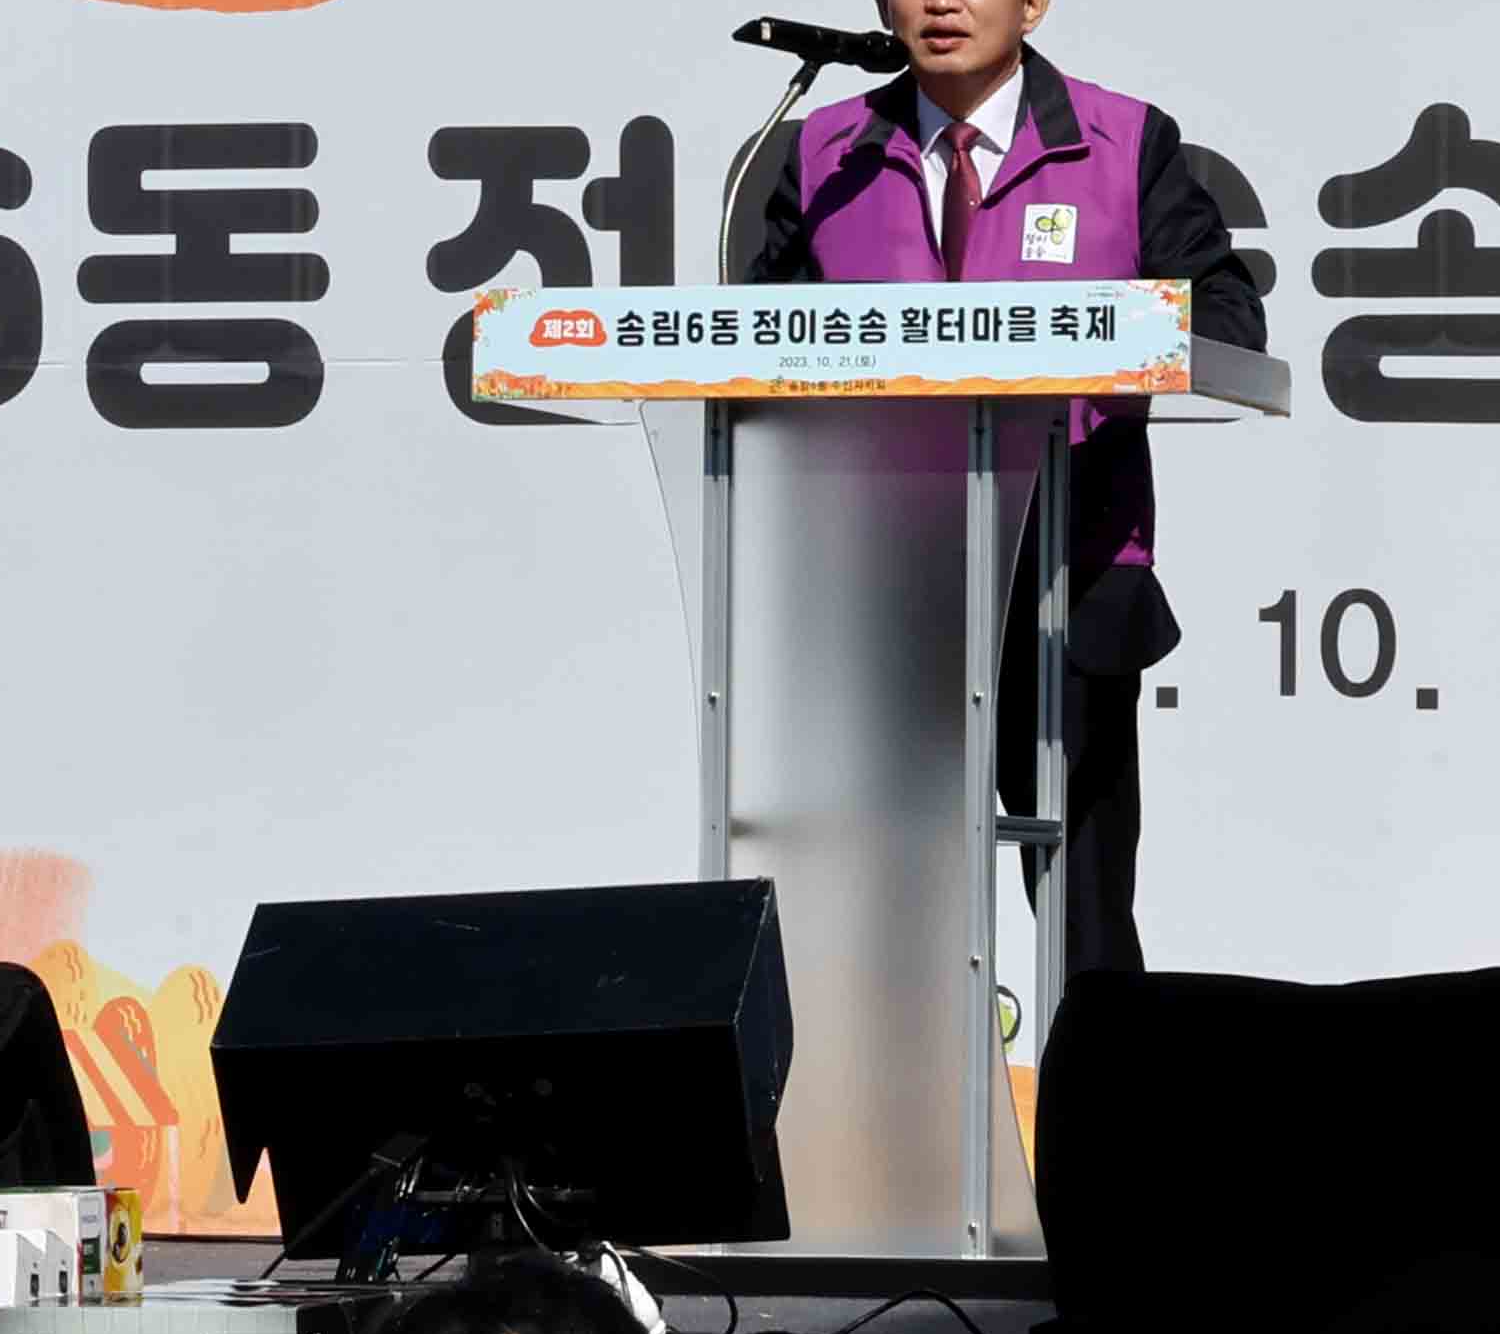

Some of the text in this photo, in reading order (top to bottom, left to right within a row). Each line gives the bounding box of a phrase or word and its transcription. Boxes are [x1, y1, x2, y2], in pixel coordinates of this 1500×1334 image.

[544, 305, 1116, 347] 제2회 송림6동 정이송송 활터마을 축제
[1256, 588, 1444, 713] 10.
